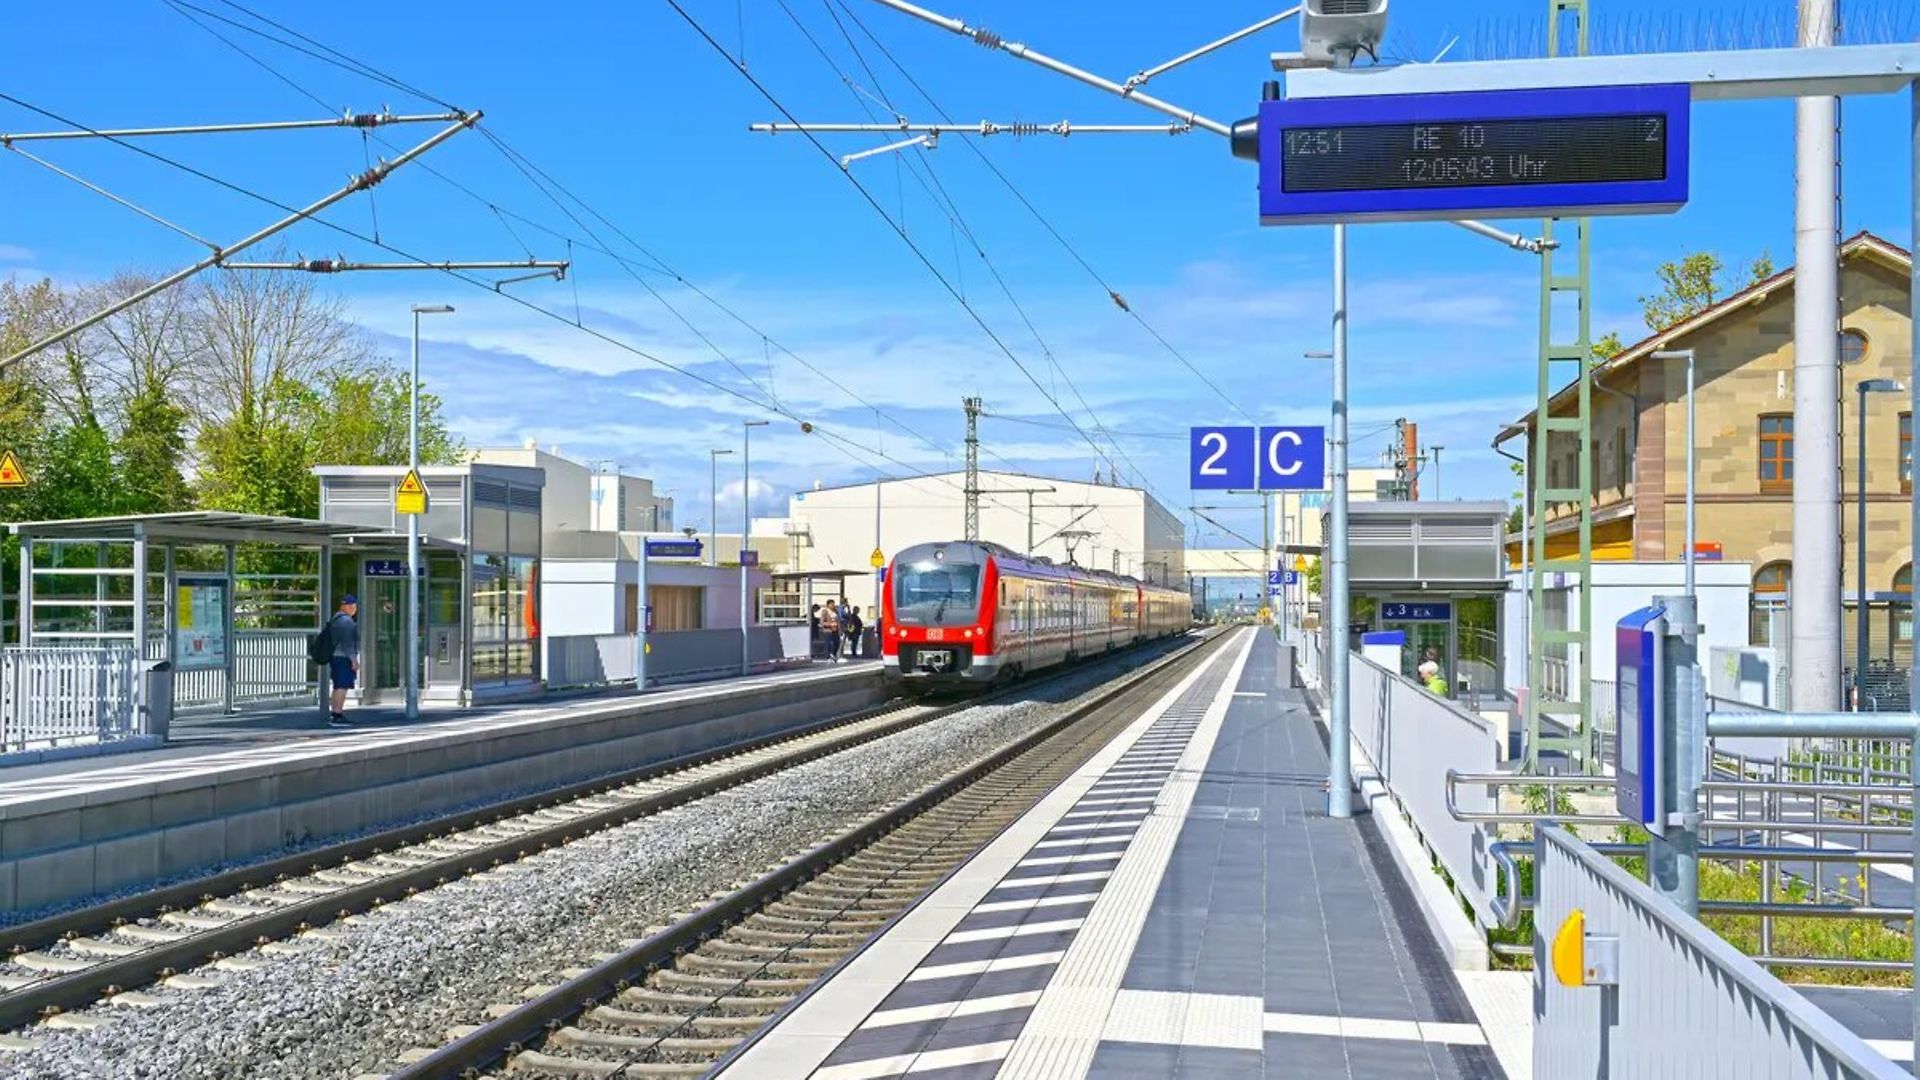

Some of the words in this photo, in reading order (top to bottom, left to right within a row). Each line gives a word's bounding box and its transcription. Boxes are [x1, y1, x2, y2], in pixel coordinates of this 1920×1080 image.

[1413, 128, 1442, 151] RE
[1459, 126, 1485, 149] 10
[1644, 119, 1660, 142] 2
[1285, 131, 1343, 155] 12:51
[1401, 156, 1494, 181] 12:06:43
[1509, 154, 1549, 179] Uhr
[1199, 432, 1228, 476] 2
[1268, 430, 1303, 476] C
[1269, 572, 1277, 583] 2
[1285, 572, 1293, 583] B
[1398, 604, 1407, 615] 3
[927, 630, 943, 639] DB
